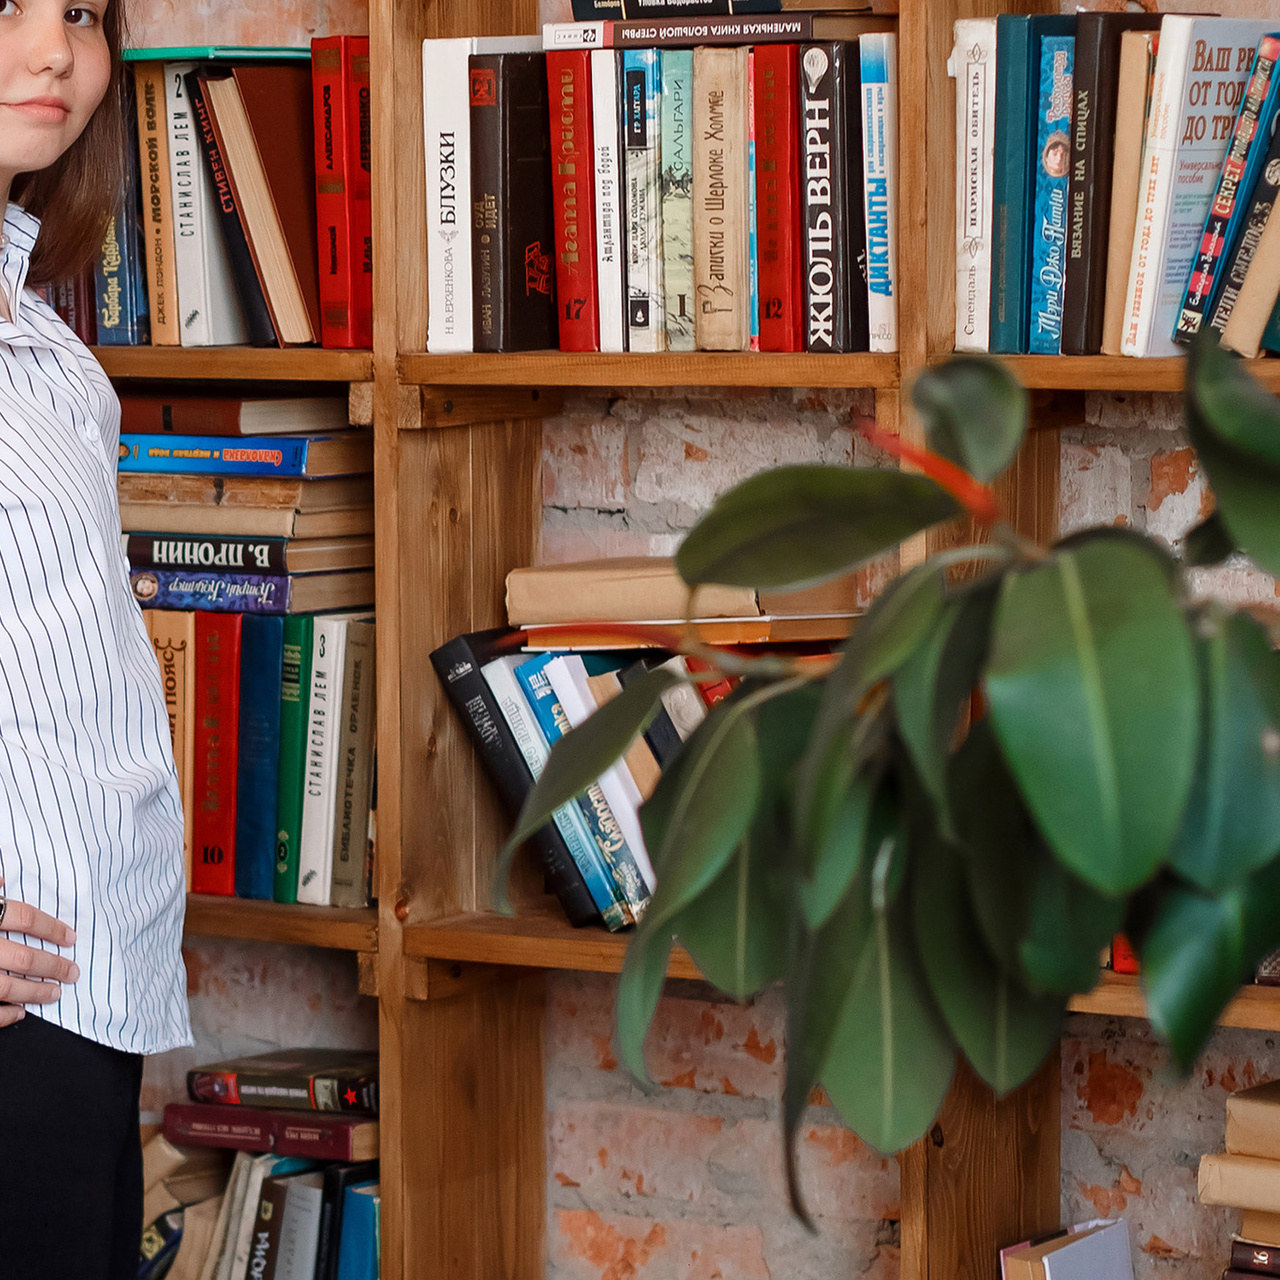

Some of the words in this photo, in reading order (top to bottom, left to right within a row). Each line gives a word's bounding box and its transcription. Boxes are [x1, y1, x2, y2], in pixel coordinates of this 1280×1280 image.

[621, 26, 657, 40] СТЕРВЫ
[659, 25, 708, 41] БОЛЬШОЙ
[710, 24, 741, 36] КНИГА
[743, 21, 801, 35] МАЛЕНЬКАЯ
[144, 81, 158, 134] ВОЛК
[174, 72, 184, 99] 2
[971, 71, 980, 139] ОБИТЕЛЬ
[1188, 81, 1212, 106] ОТ
[173, 111, 189, 141] ЛЕМ
[194, 98, 215, 145] КИНГ
[322, 84, 335, 171] АЛЕКСАНДРОВ
[558, 69, 576, 175] Кристи
[673, 78, 685, 172] САЛЬГАРИ
[704, 90, 725, 142] Холмсе
[1076, 89, 1090, 153] СПИЦАХ
[1182, 115, 1206, 146] ДО
[806, 98, 831, 206] ВЕРН
[1074, 158, 1085, 184] НА
[145, 136, 162, 224] МОРСКОЙ
[175, 149, 195, 238] СТАНИСЛАВ
[207, 147, 235, 214] СТИВЕН
[439, 131, 456, 227] БЛУЗКИ
[705, 148, 728, 211] Шерлоке
[969, 147, 979, 228] ПАРМСКАЯ
[1214, 164, 1242, 216] СЕКРЕТ
[475, 201, 484, 229] СУД
[484, 194, 497, 229] ИДЕТ
[559, 183, 579, 276] Агата
[601, 198, 615, 263] Атлантида
[869, 177, 893, 297] ДИКТАНТЫ
[1042, 187, 1065, 246] Патни
[1070, 191, 1085, 260] ВЯЗАНИЕ
[154, 236, 165, 289] ЛОНДОН
[482, 248, 492, 299] ЛАЗУТИН
[809, 211, 833, 347] ЖЮЛЬ
[1039, 244, 1061, 290] Джо
[103, 278, 121, 329] Барбара
[157, 299, 166, 325] ДЖЕК
[482, 302, 493, 335] ИВАН
[565, 297, 587, 321] 17
[764, 298, 783, 320] 12
[963, 265, 977, 336] Стендаль
[1037, 289, 1061, 340] Мэри
[222, 448, 283, 466] Скалолазка
[153, 540, 244, 566] ПРОНИН
[248, 544, 270, 567] В.
[319, 634, 326, 658] 3
[314, 670, 327, 702] ЛЕМ
[309, 708, 326, 797] СТАНИСЛАВ
[341, 746, 356, 863] БИБЛИОТЕЧКА
[203, 845, 224, 865] 10
[1253, 1250, 1269, 1266] 16
